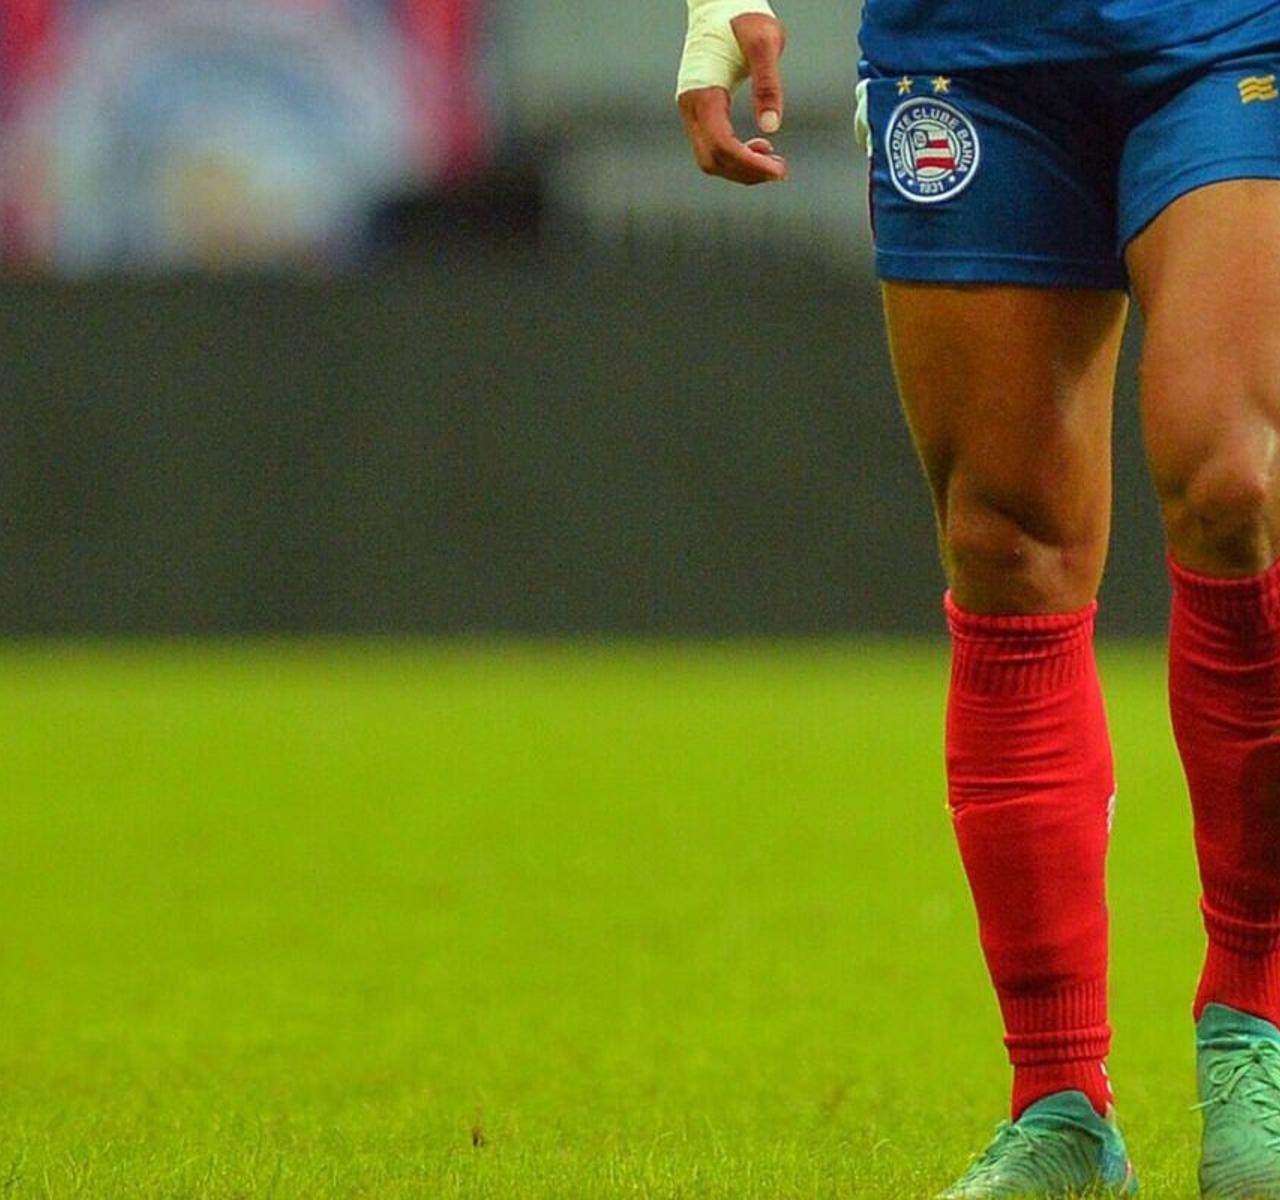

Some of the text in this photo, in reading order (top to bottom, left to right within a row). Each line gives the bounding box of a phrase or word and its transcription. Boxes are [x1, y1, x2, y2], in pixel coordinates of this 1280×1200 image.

[891, 107, 973, 179] ESPORTE CLUBE BAHIA
[920, 181, 945, 193] 1931
